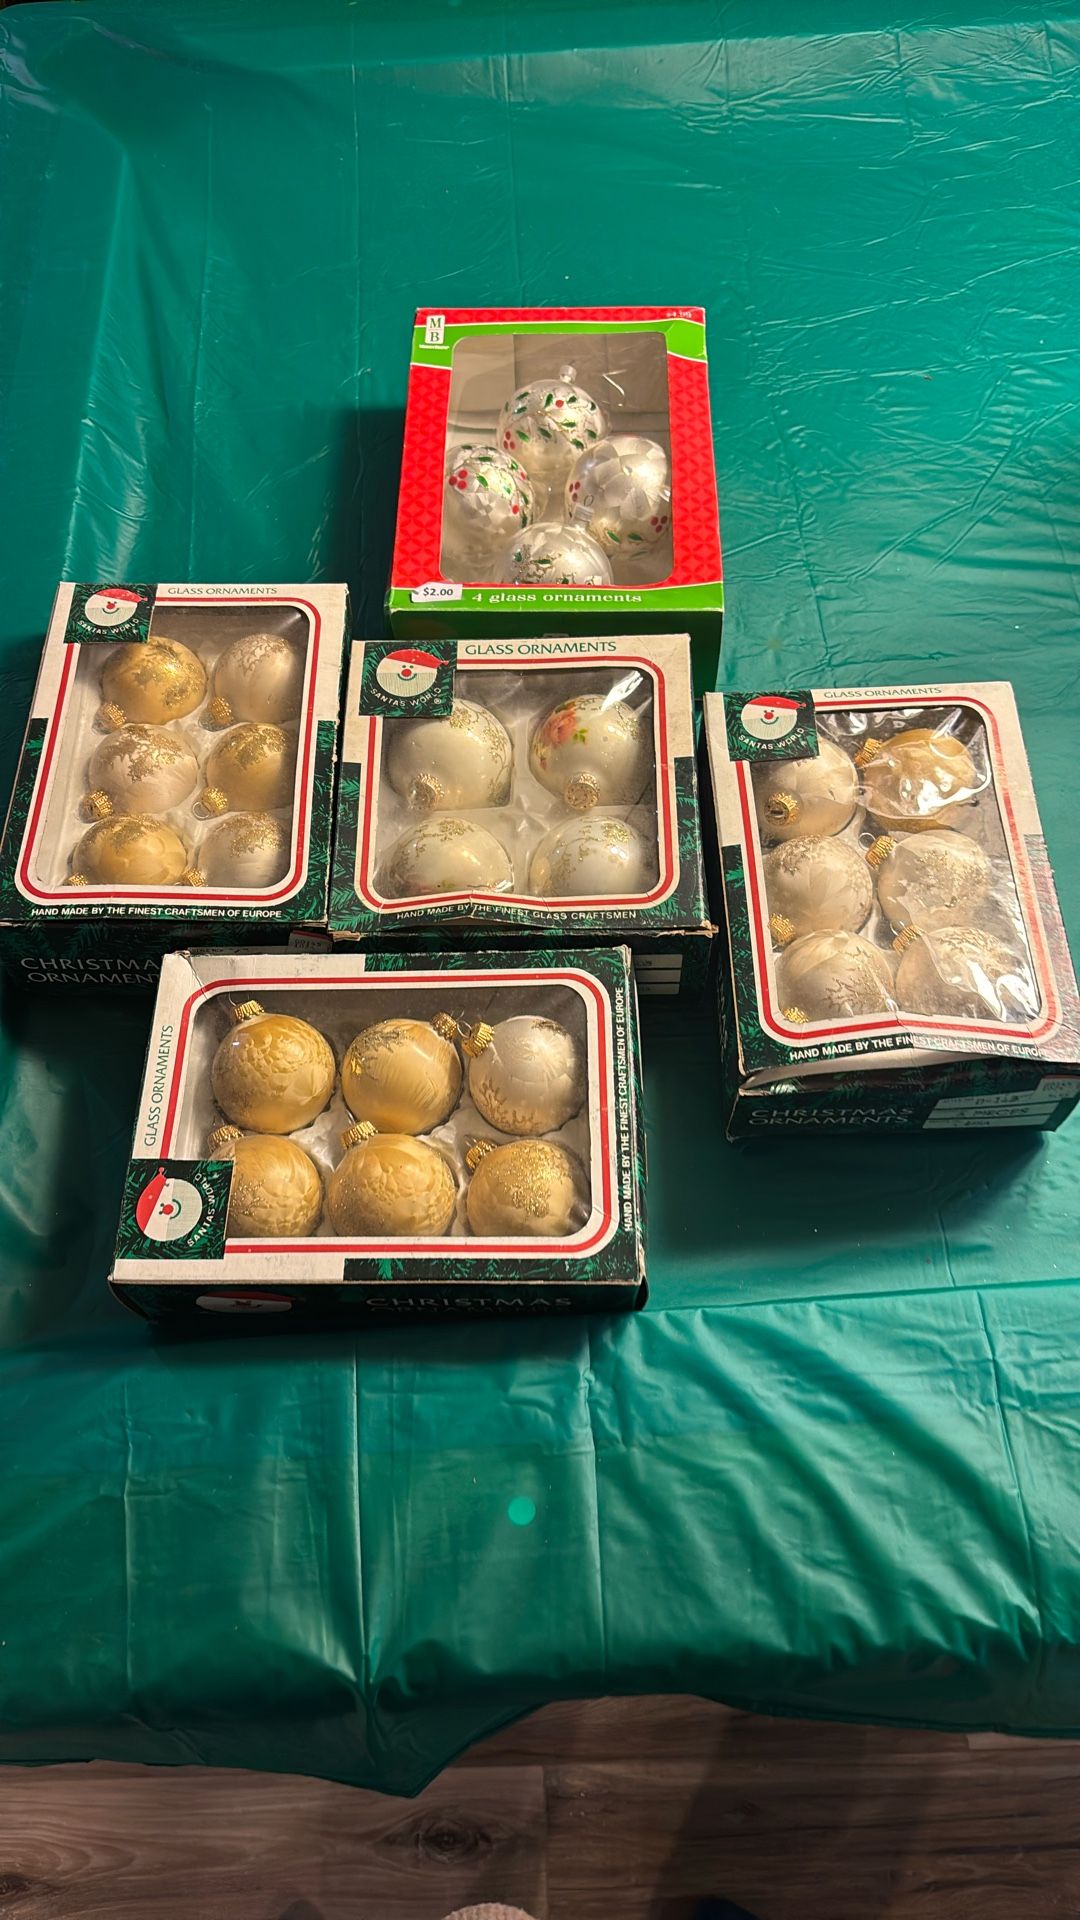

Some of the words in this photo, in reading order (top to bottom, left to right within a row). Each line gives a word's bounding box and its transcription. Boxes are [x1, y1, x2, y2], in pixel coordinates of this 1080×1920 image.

[429, 317, 442, 329] M
[430, 331, 440, 342] B
[167, 586, 204, 595] GLASS
[206, 586, 278, 595] ORNAMENTS
[423, 586, 454, 597] $2.00
[472, 592, 484, 602] 4
[488, 591, 537, 604] glass
[543, 592, 642, 603] ornaments
[110, 618, 140, 634] WORLD
[465, 643, 514, 655] GLASS
[517, 641, 617, 654] ORNAMENTS
[409, 687, 442, 707] WORLD
[823, 689, 862, 699] GLASS
[864, 686, 942, 698] ORNAMENTS
[776, 726, 805, 748] WORLD
[31, 908, 59, 916] HAND
[61, 907, 89, 916] MADE
[91, 906, 105, 915] BY
[106, 906, 126, 915] THE
[128, 907, 163, 916] FINEST
[164, 907, 226, 917] CRAFTSMEN
[227, 908, 241, 917] OF
[242, 909, 282, 918] EUROPE
[396, 909, 424, 920] HAND
[426, 905, 455, 916] MADE
[457, 903, 470, 911] BY
[473, 903, 493, 913] THE
[495, 906, 529, 917] FINEST
[532, 911, 568, 920] GLASS
[570, 911, 637, 920] CRAFTSMEN
[20, 957, 160, 970] CHRISTMA
[27, 972, 160, 983] ORNAMENT
[615, 987, 625, 1023] EUROPE
[616, 1025, 626, 1038] OF
[789, 1047, 820, 1061] HAND
[822, 1042, 853, 1056] MADE
[855, 1040, 869, 1051] BY
[872, 1037, 894, 1049] THE
[896, 1034, 931, 1047] FINEST
[933, 1037, 996, 1050] CRAFTSMEN
[996, 1042, 1011, 1052] OF
[151, 1025, 174, 1104] ORNAMENTS
[617, 1039, 628, 1096] CRAFTSMEN
[619, 1097, 629, 1130] FINEST
[751, 1108, 914, 1118] CHRISTMAS
[144, 1106, 161, 1147] GLASS
[749, 1116, 909, 1126] ORNAMENTS
[620, 1132, 630, 1151] THE
[621, 1155, 631, 1168] BY
[194, 1173, 216, 1207] WORLD
[622, 1169, 632, 1199] MADE
[623, 1202, 633, 1232] HAND
[366, 1297, 573, 1307] CHRISTMAS
